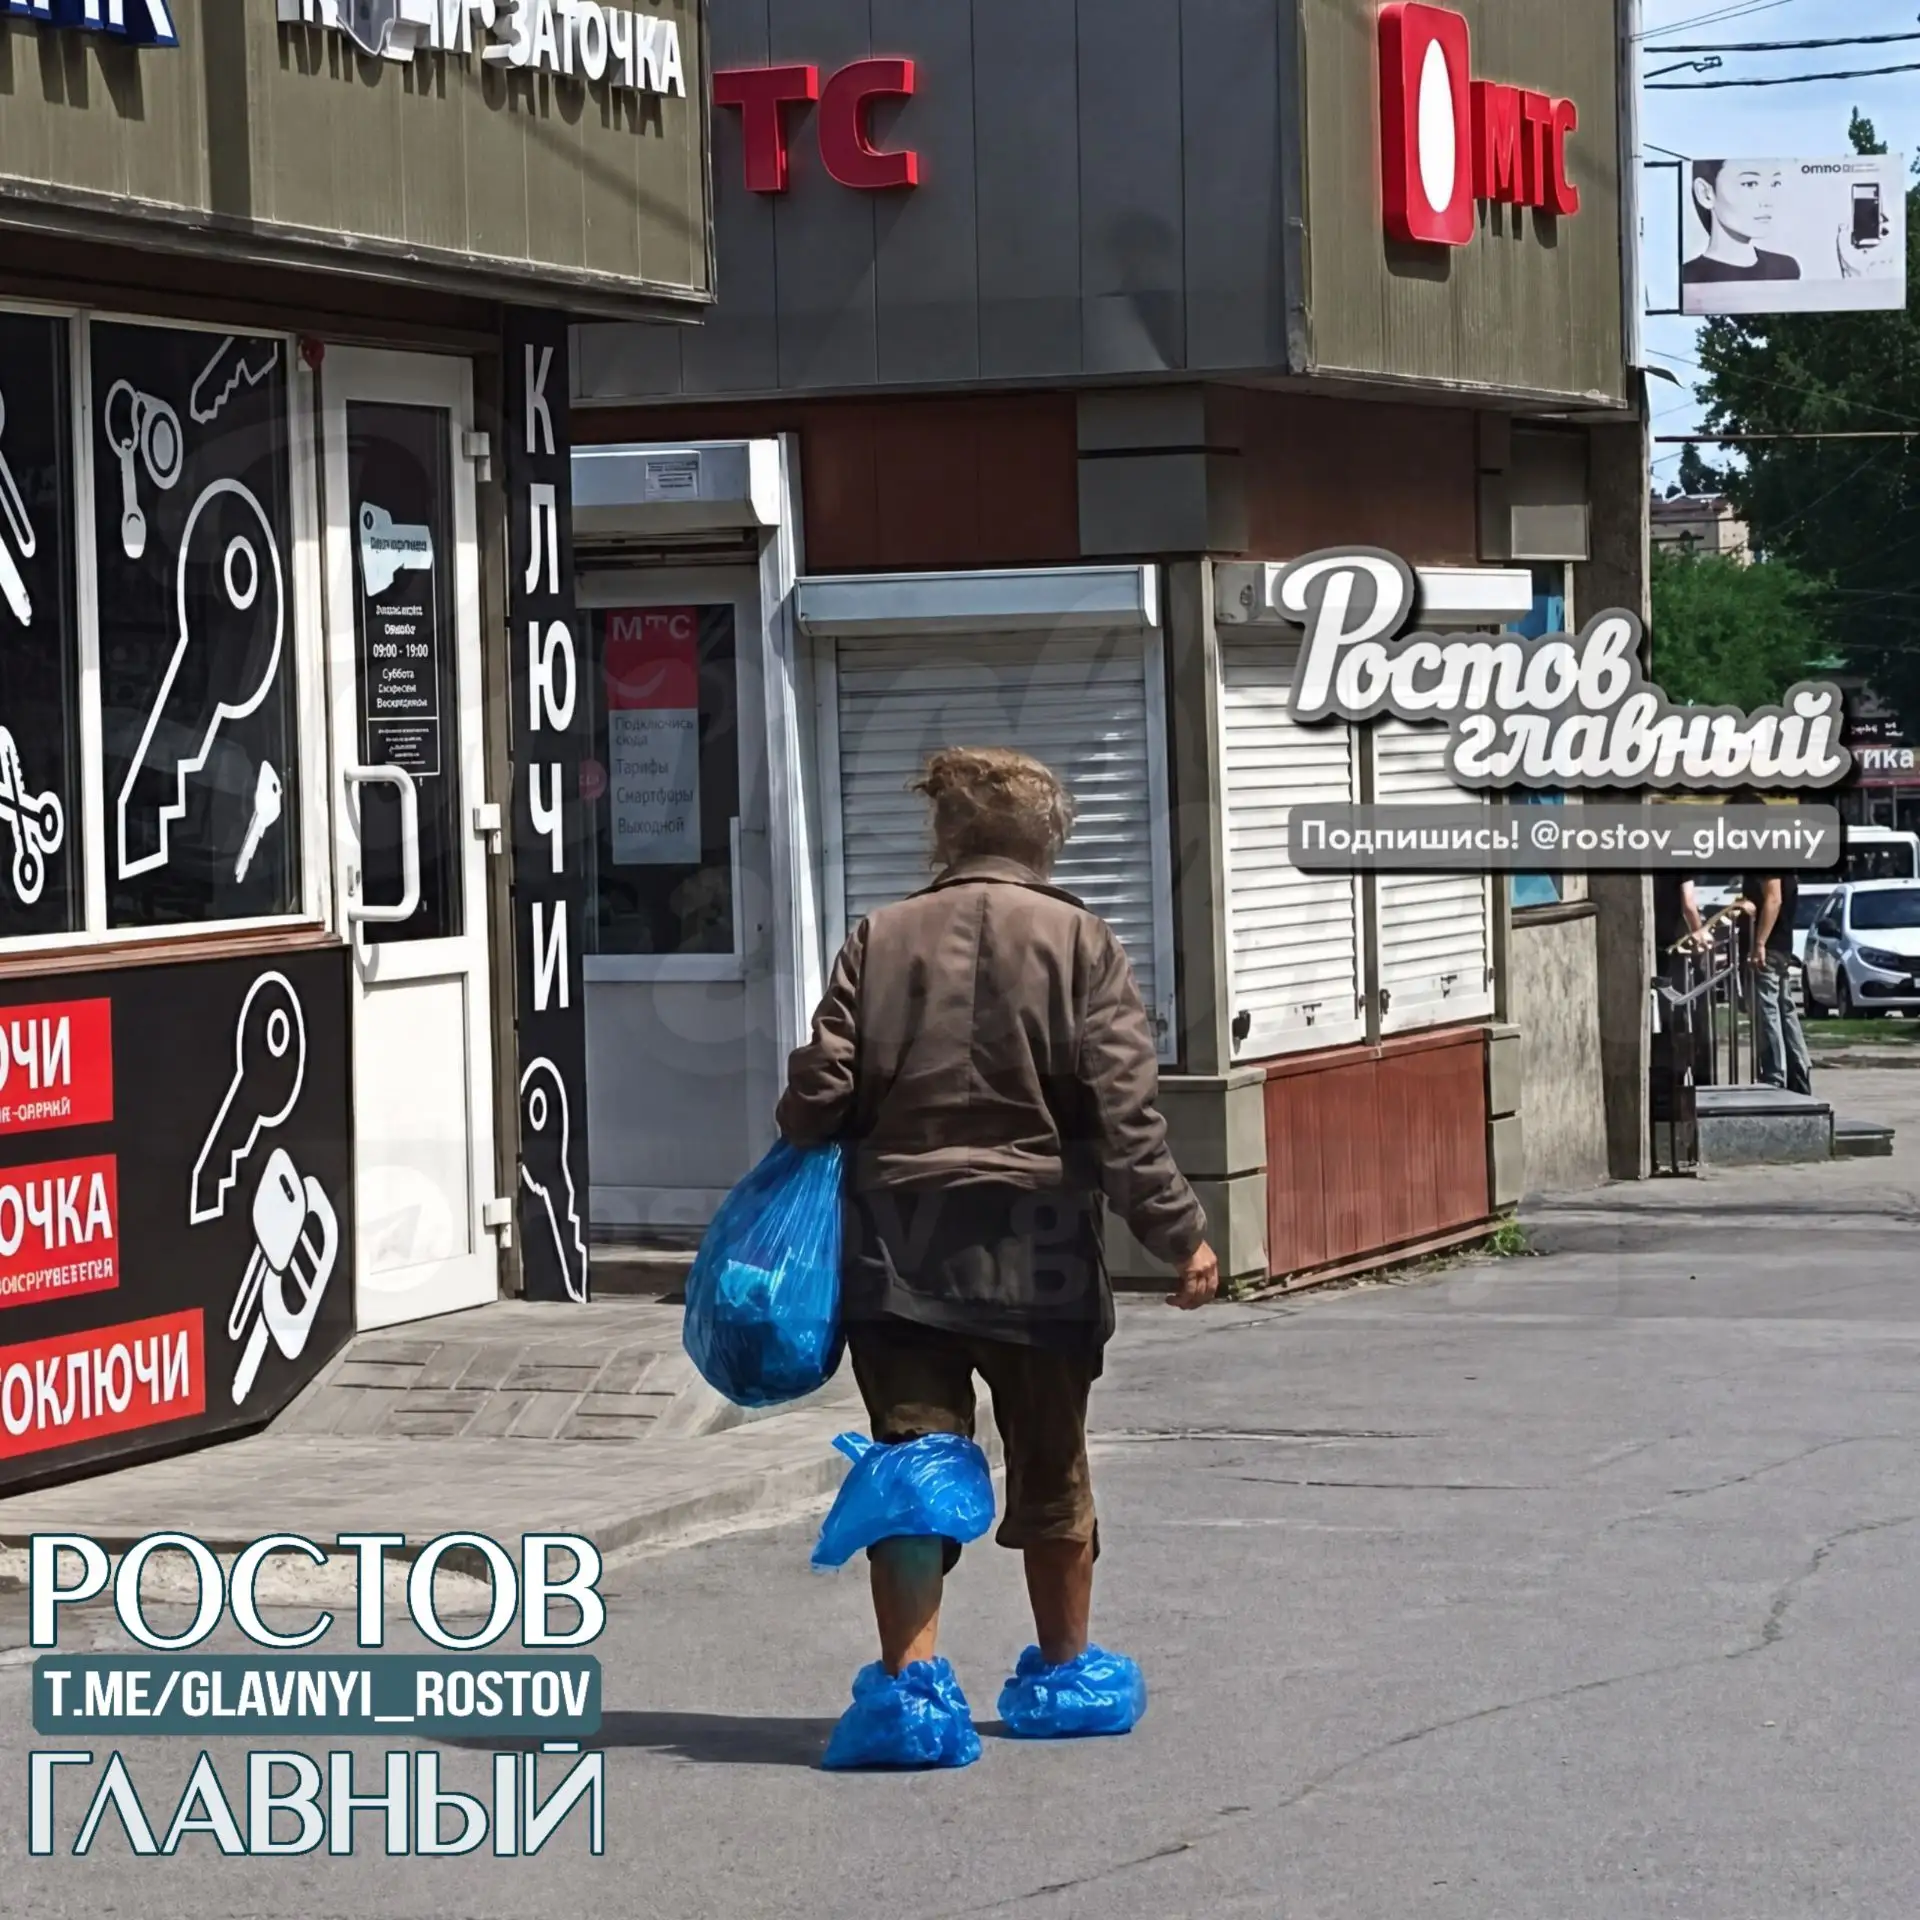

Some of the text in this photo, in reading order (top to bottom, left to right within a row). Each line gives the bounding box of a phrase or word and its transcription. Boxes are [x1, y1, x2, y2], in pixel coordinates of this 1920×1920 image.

[482, 0, 687, 98] ЗАТОЧКА
[1470, 80, 1579, 216] МТС
[373, 643, 397, 658] 09:00
[405, 643, 429, 658] 19:00
[382, 667, 415, 682] Суббота
[523, 342, 577, 1012] КЛЮЧИ
[616, 758, 669, 779] Тарифы
[618, 816, 685, 836] Выходной
[0, 1172, 113, 1257] ОЧКА
[0, 1330, 190, 1436] ОКЛЮЧИ
